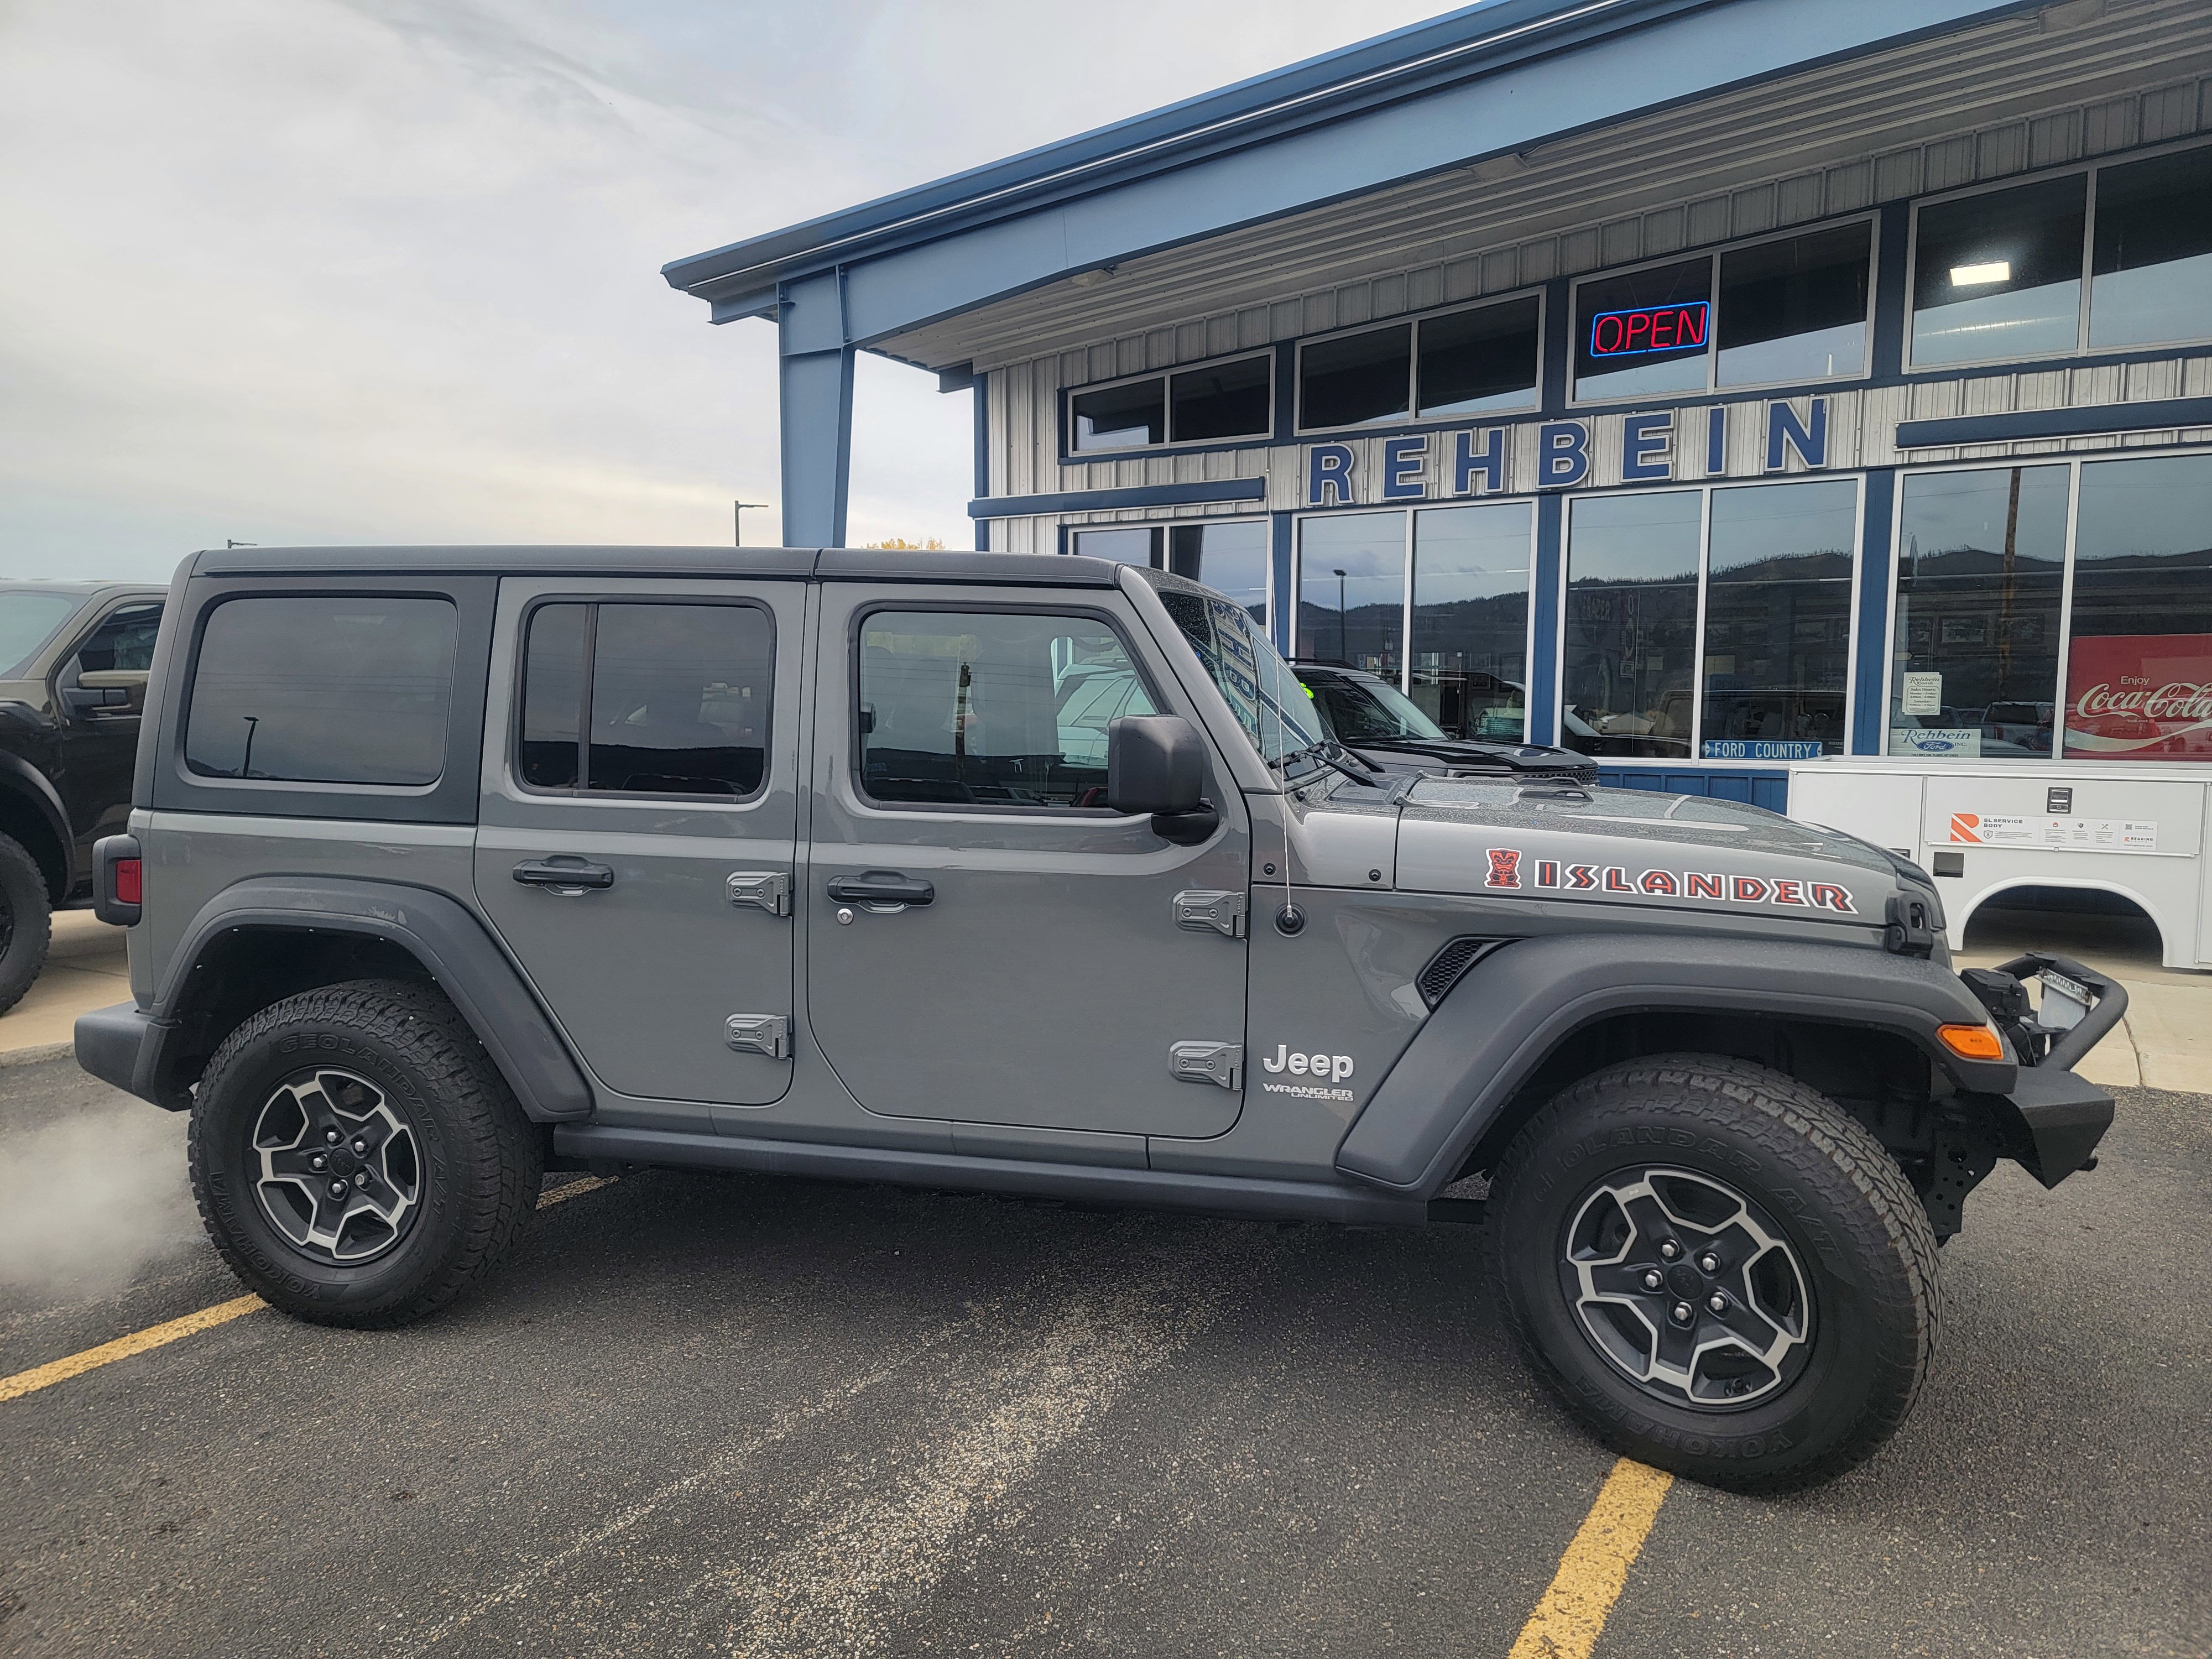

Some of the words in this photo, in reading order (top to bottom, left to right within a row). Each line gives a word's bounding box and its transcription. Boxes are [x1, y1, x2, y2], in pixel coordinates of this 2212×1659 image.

[1595, 306, 1706, 353] OPEN
[1307, 395, 1832, 508] REHBEIN
[2121, 676, 2150, 685] Enjoy
[2077, 682, 2212, 718] Coca-Cola
[1901, 729, 1971, 745] Rehbein
[1923, 741, 1947, 750] Ford
[1714, 742, 1745, 758] FORD
[1755, 743, 1812, 759] COUNTRY
[1534, 859, 1859, 915] ISLANDER
[1262, 1044, 1354, 1083] Jeep
[1262, 1083, 1354, 1097] WRANGLER
[1291, 1093, 1354, 1102] UNLIMITED
